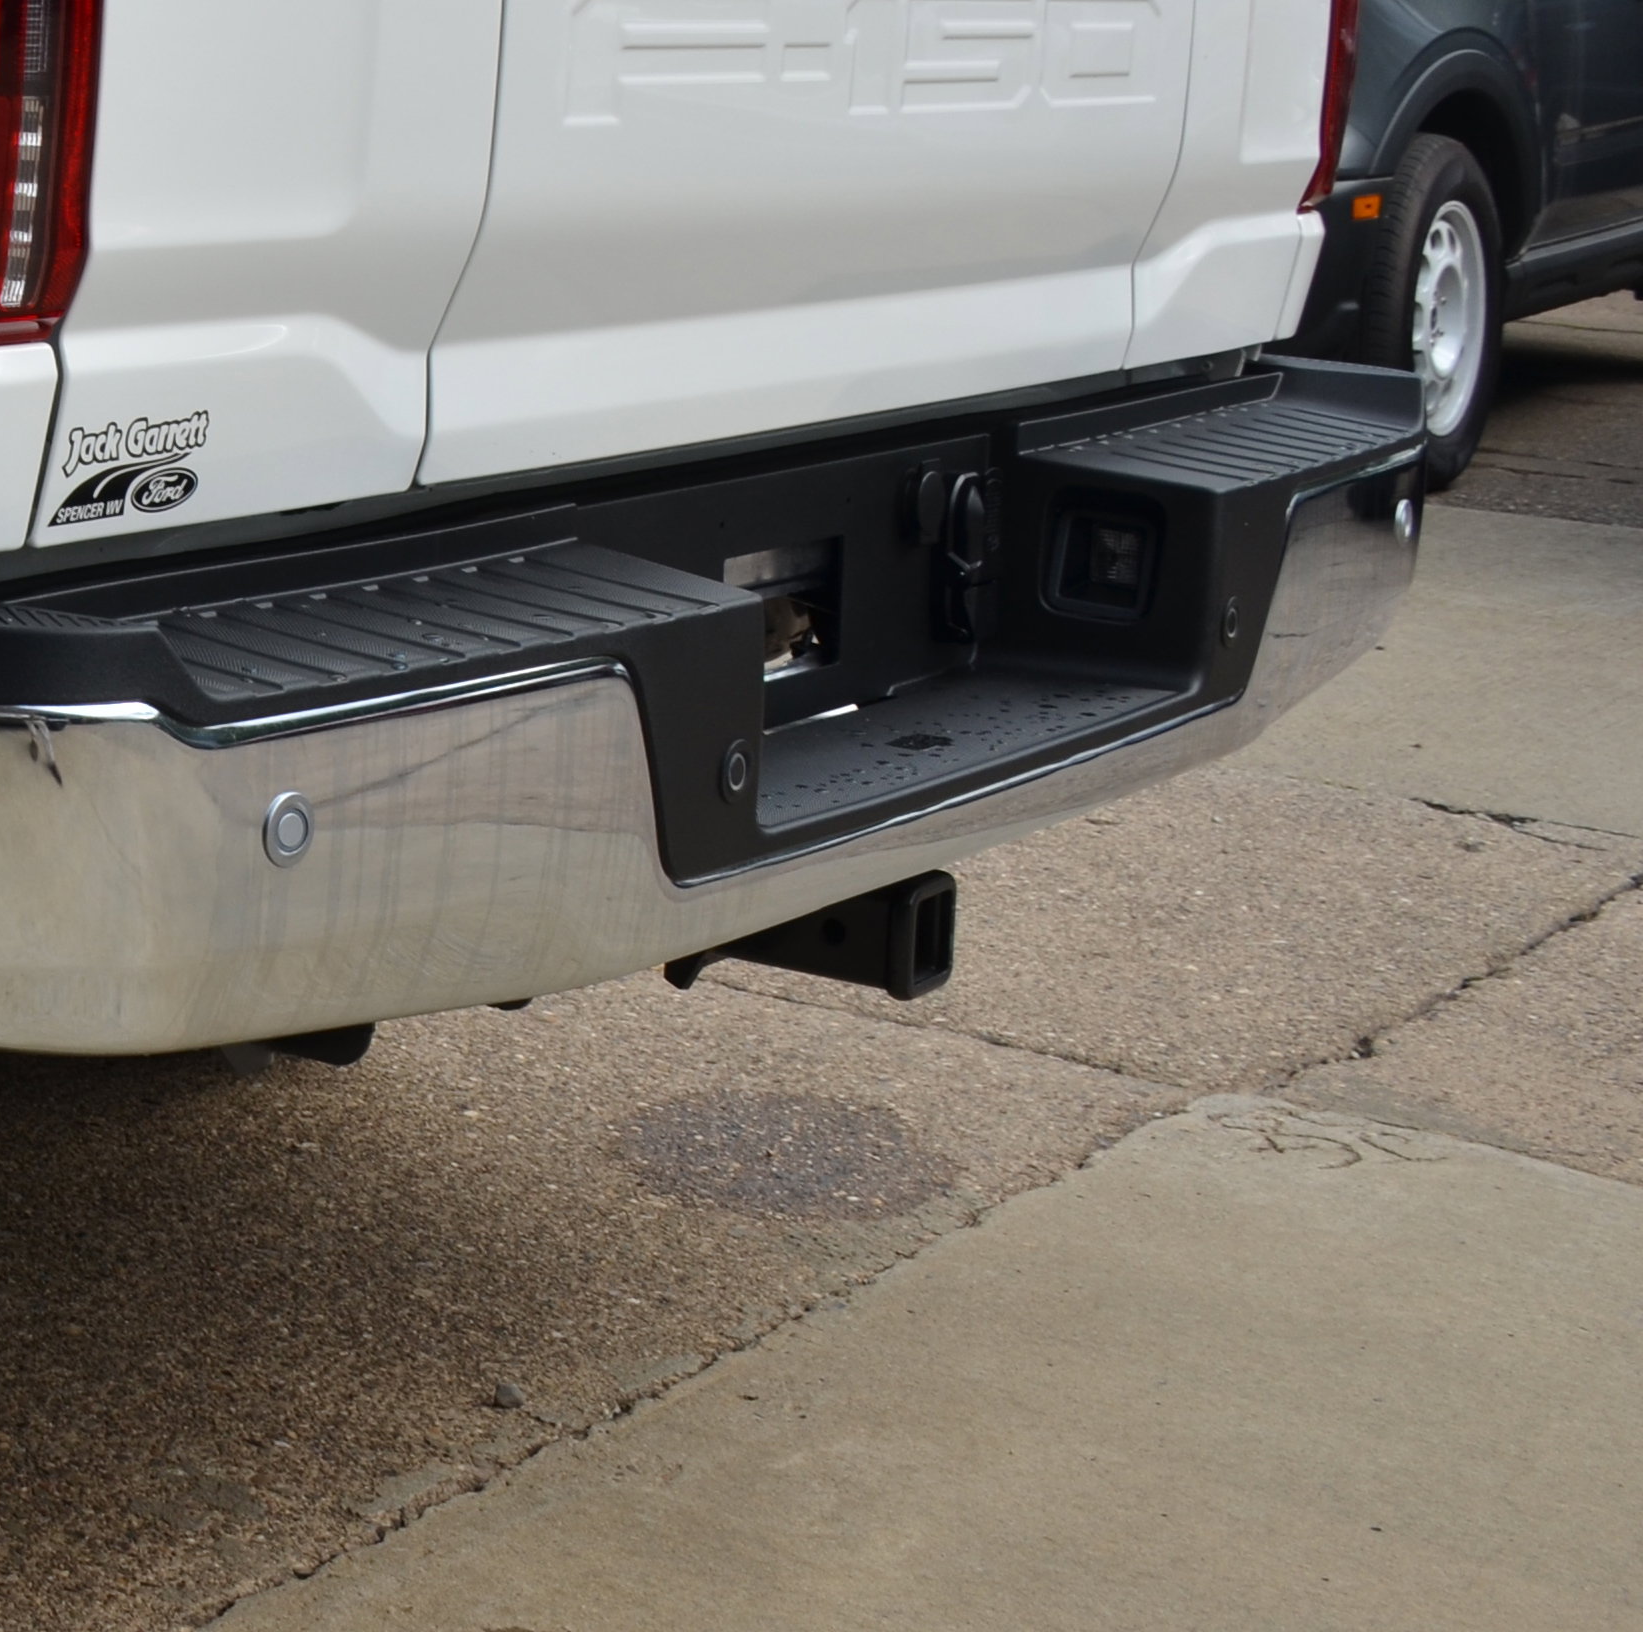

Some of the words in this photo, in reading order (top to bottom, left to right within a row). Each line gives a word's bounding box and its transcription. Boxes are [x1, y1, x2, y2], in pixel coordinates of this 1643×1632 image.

[62, 422, 122, 478] Jack
[126, 410, 209, 459] Garrett
[142, 474, 186, 506] Ford
[56, 501, 105, 525] SPENCER
[106, 498, 124, 516] WV
